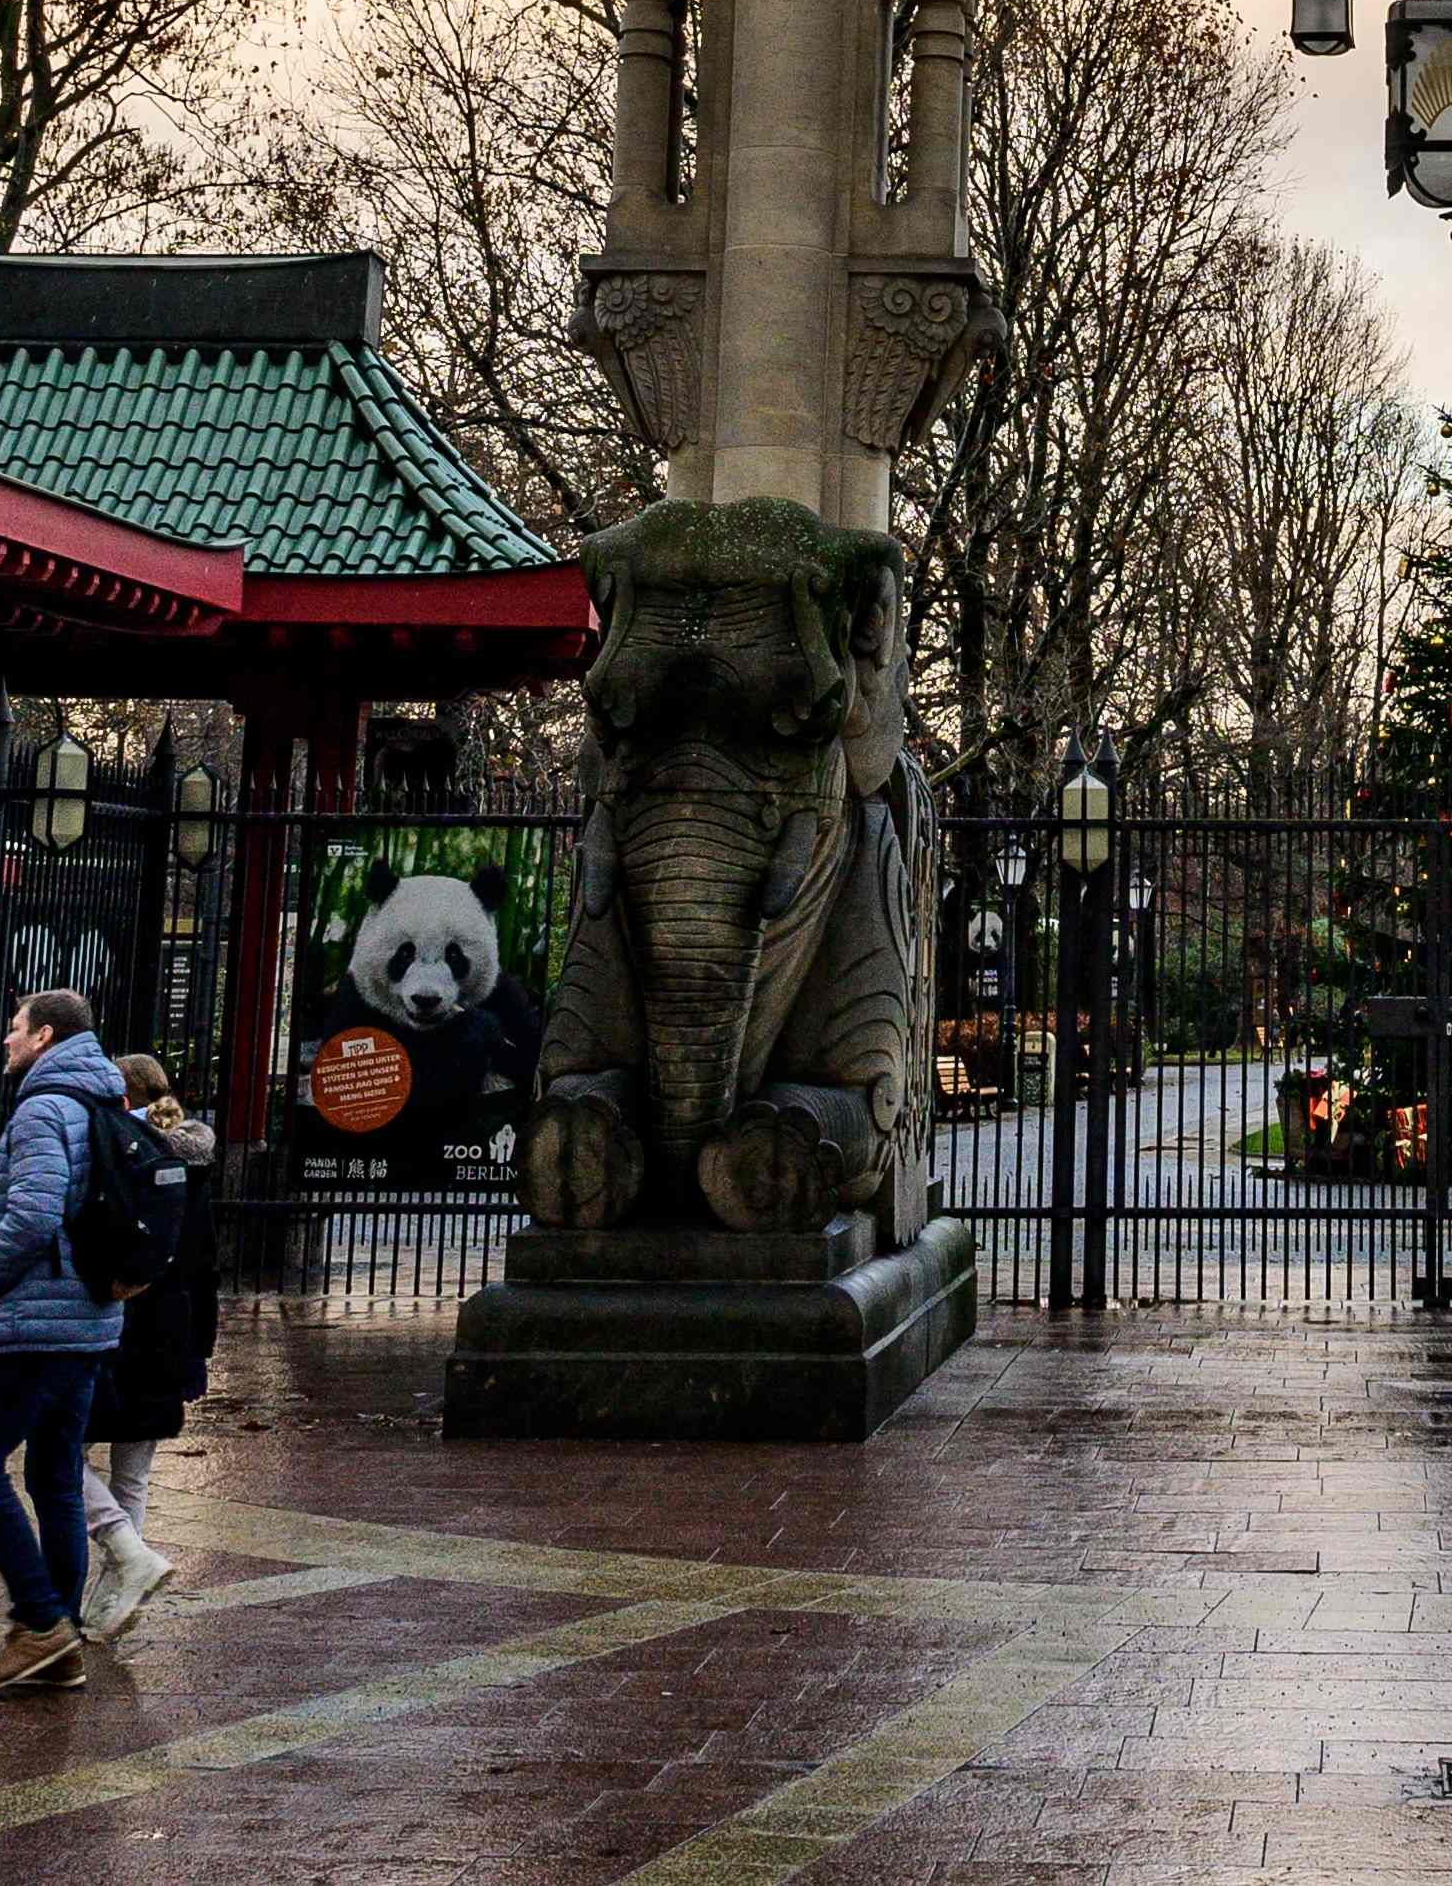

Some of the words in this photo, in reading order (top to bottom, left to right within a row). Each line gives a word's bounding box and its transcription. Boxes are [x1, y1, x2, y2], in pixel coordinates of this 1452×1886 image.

[348, 1042, 368, 1055] TIPP
[443, 1145, 482, 1159] ZOO
[304, 1158, 337, 1168] PANDA
[304, 1169, 337, 1179] GARDEN
[455, 1165, 518, 1181] BERLIN
